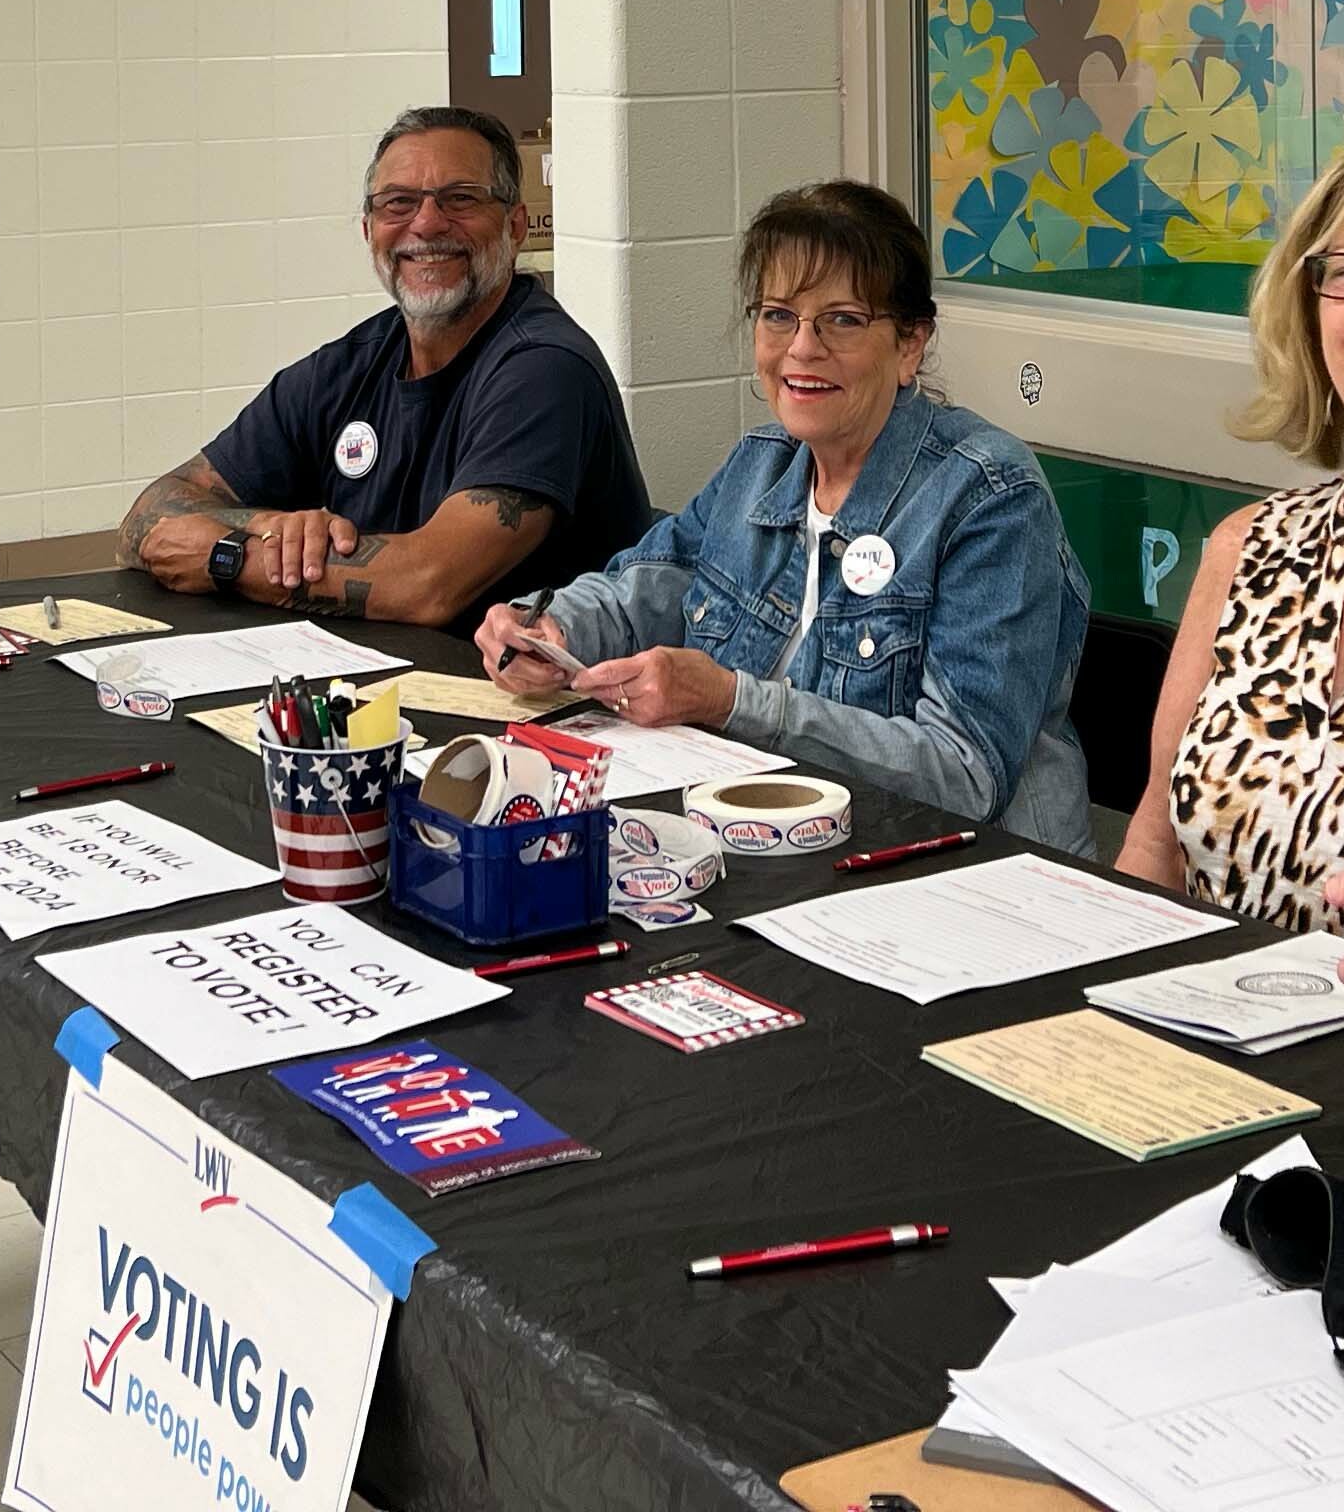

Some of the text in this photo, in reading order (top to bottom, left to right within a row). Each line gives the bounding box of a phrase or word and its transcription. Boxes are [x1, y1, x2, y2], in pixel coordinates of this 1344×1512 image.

[27, 822, 162, 884] BE 18 ON OR
[72, 813, 194, 871] IF YOU WILL
[0, 879, 77, 912] 2024
[643, 879, 674, 896] Vote
[152, 940, 208, 969] TO
[212, 931, 379, 1026] REGISTER
[279, 918, 425, 998] YOU CAN
[193, 1135, 233, 1198] LWV
[98, 1224, 315, 1482] VOTING IS
[126, 1373, 211, 1476] people
